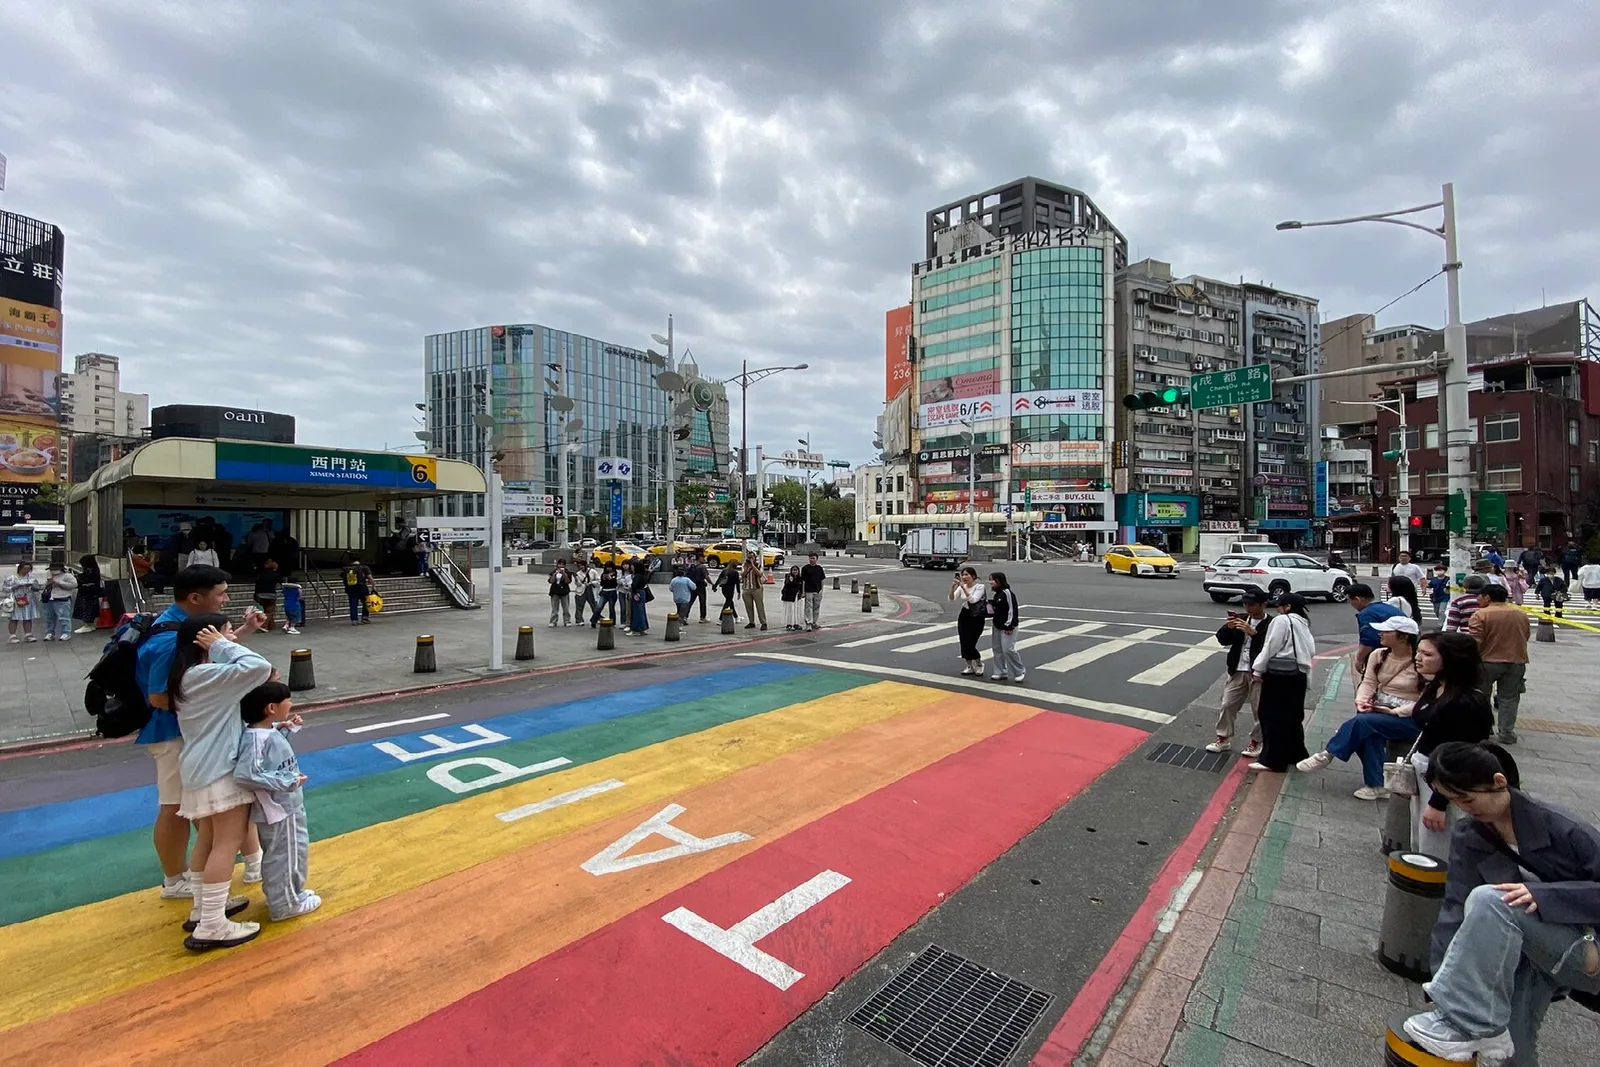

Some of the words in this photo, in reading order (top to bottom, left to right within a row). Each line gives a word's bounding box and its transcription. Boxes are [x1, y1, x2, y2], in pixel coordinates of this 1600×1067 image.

[1199, 367, 1261, 386] 成都路
[960, 401, 979, 416] 6/F
[311, 456, 367, 472] 西門站
[412, 464, 428, 483] 6
